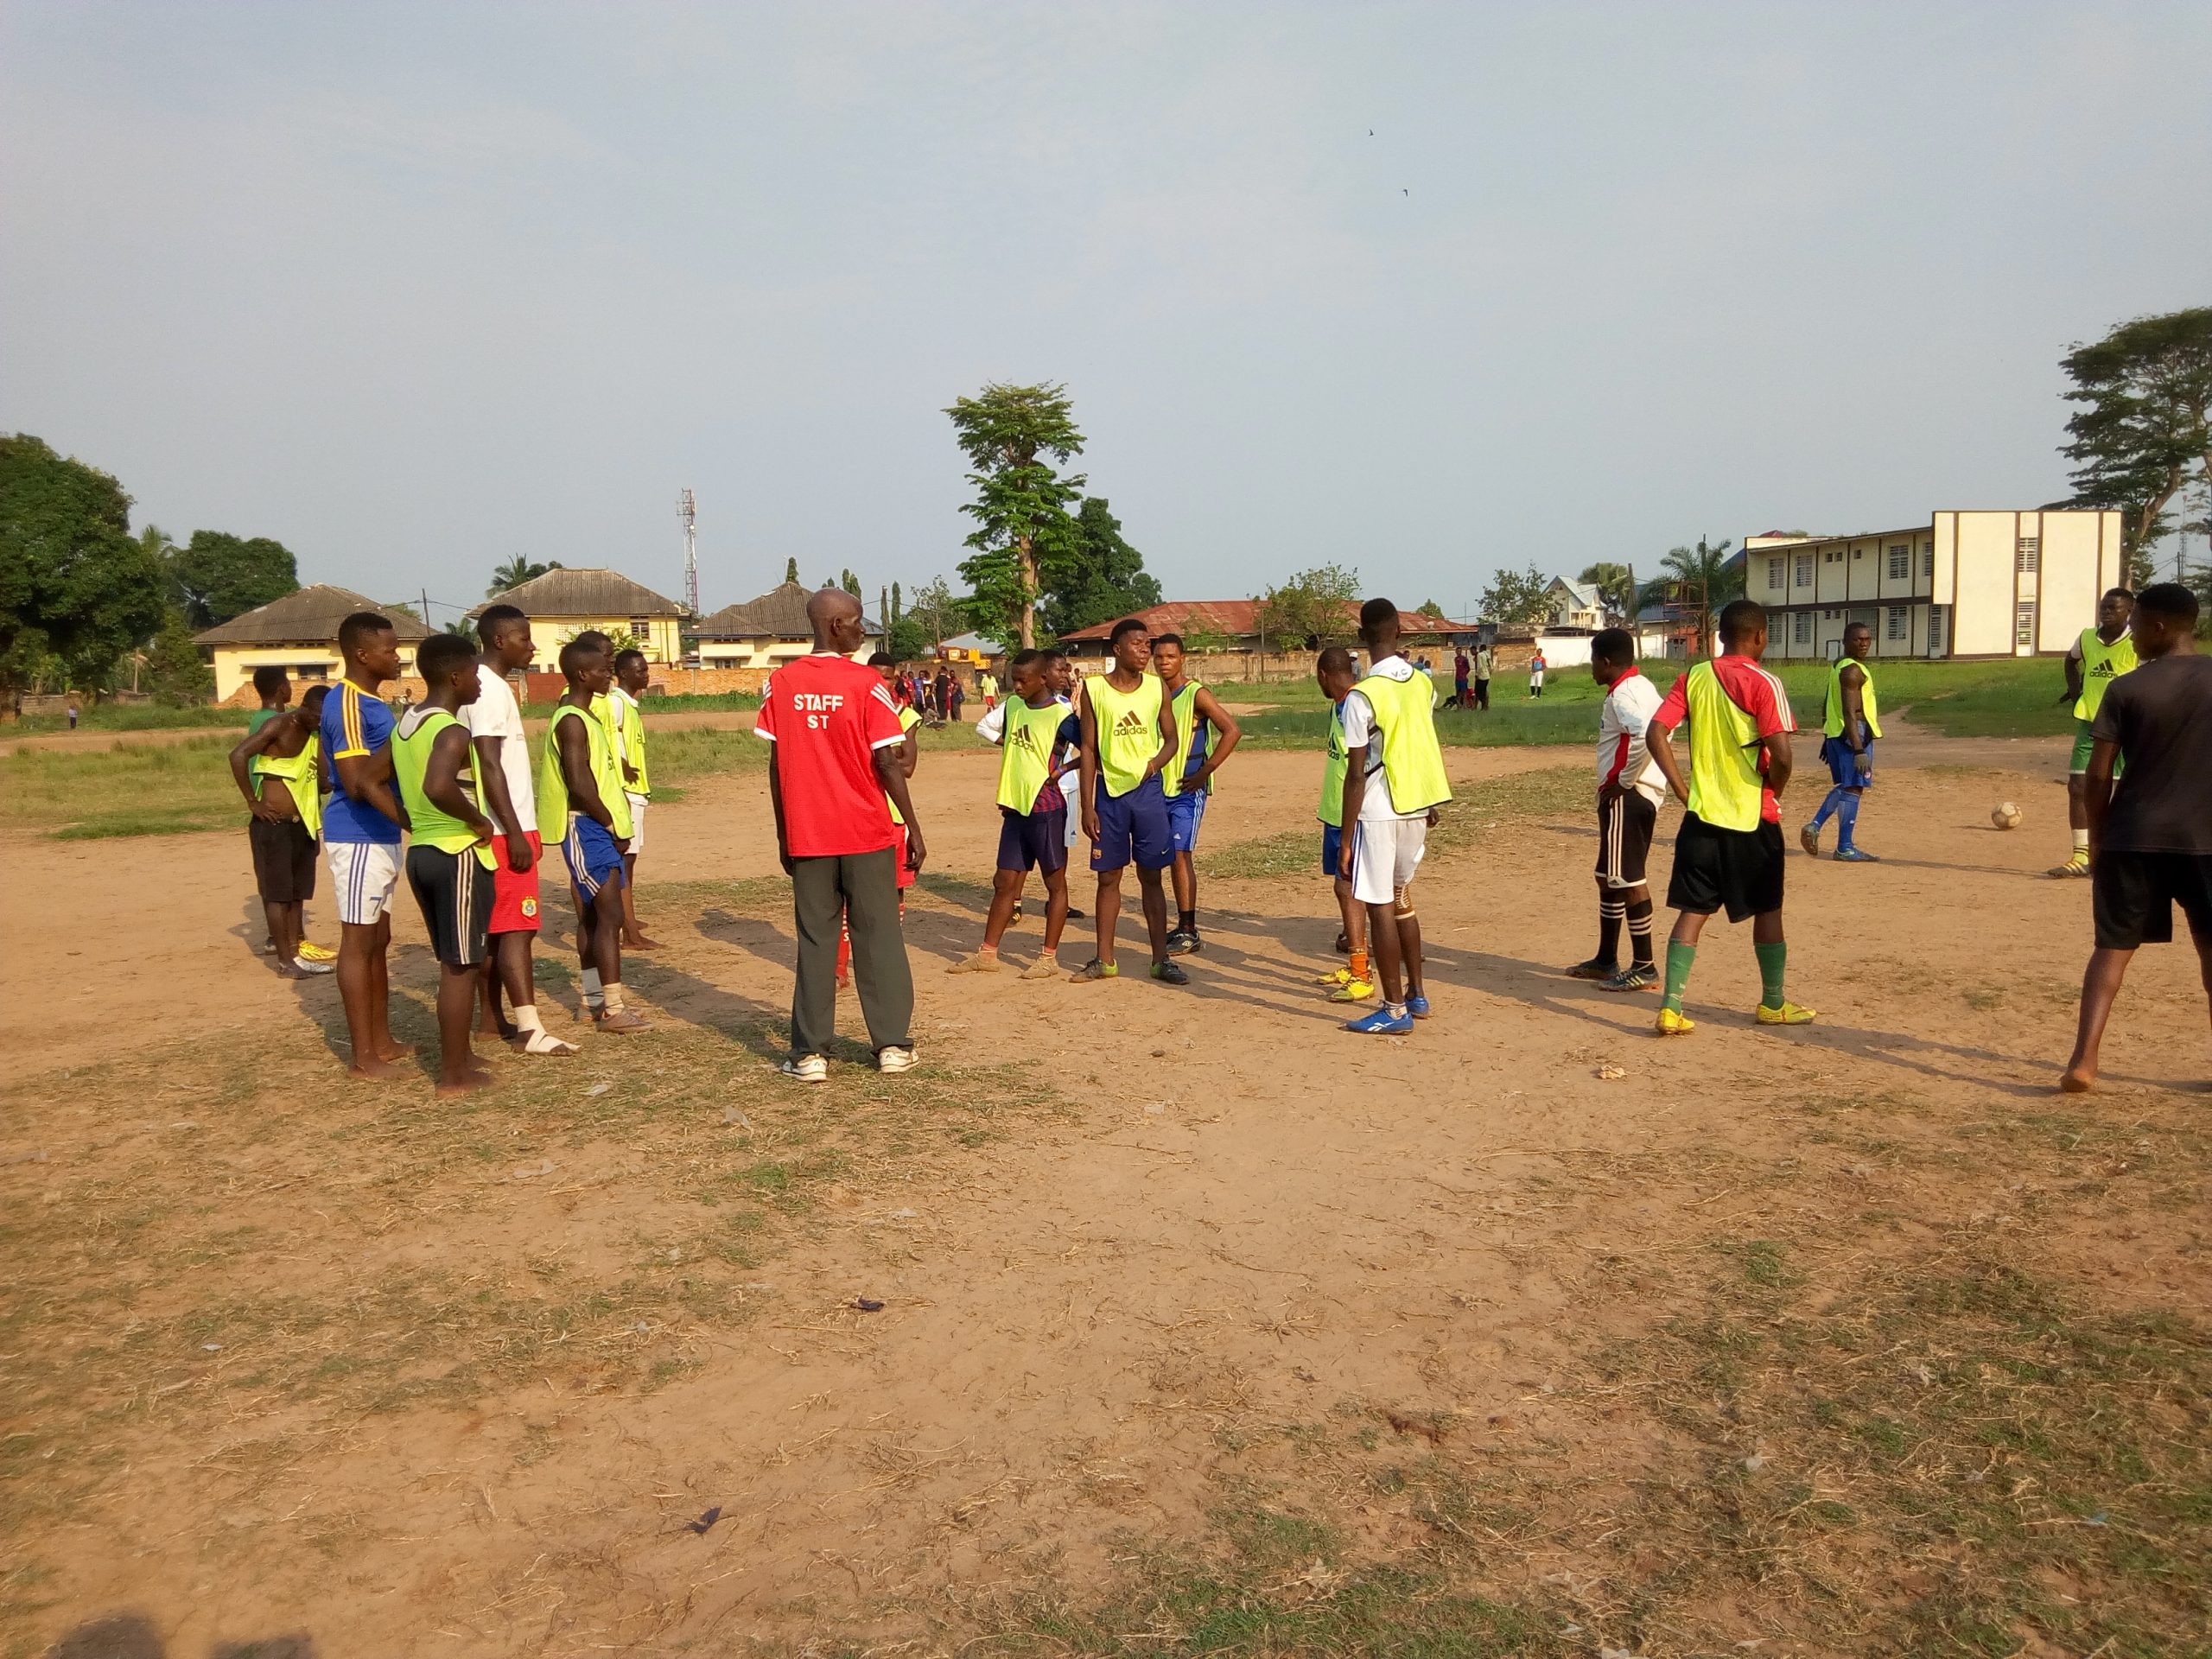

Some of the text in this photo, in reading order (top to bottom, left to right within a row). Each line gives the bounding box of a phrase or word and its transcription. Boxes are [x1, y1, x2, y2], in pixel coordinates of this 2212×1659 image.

[793, 693, 844, 712] STAFF
[807, 715, 830, 729] ST
[1113, 725, 1147, 736] adidas
[370, 896, 382, 917] 7
